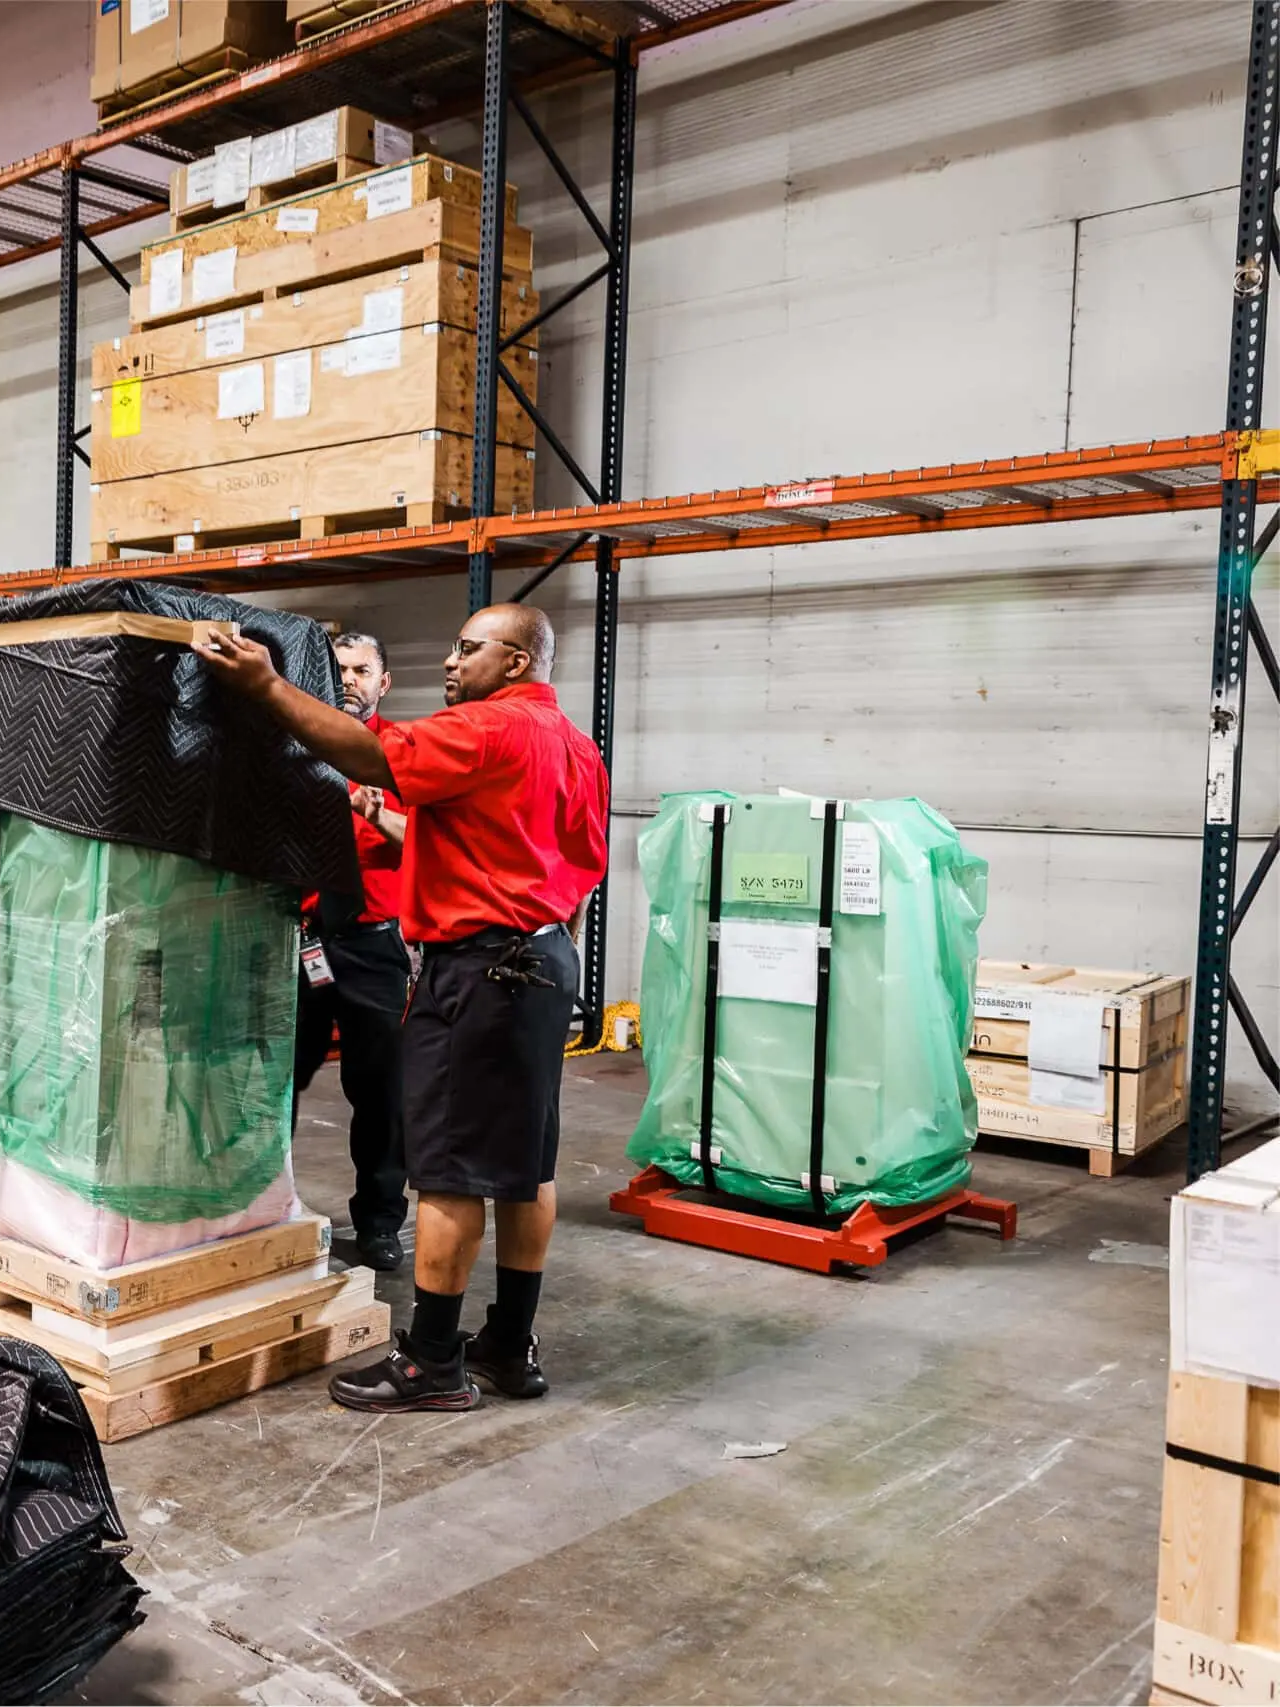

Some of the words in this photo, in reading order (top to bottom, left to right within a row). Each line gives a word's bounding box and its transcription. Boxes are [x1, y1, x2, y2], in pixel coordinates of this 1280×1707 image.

[740, 876, 765, 889] S/N
[771, 876, 804, 889] 5479
[1189, 1651, 1244, 1690] BOX
